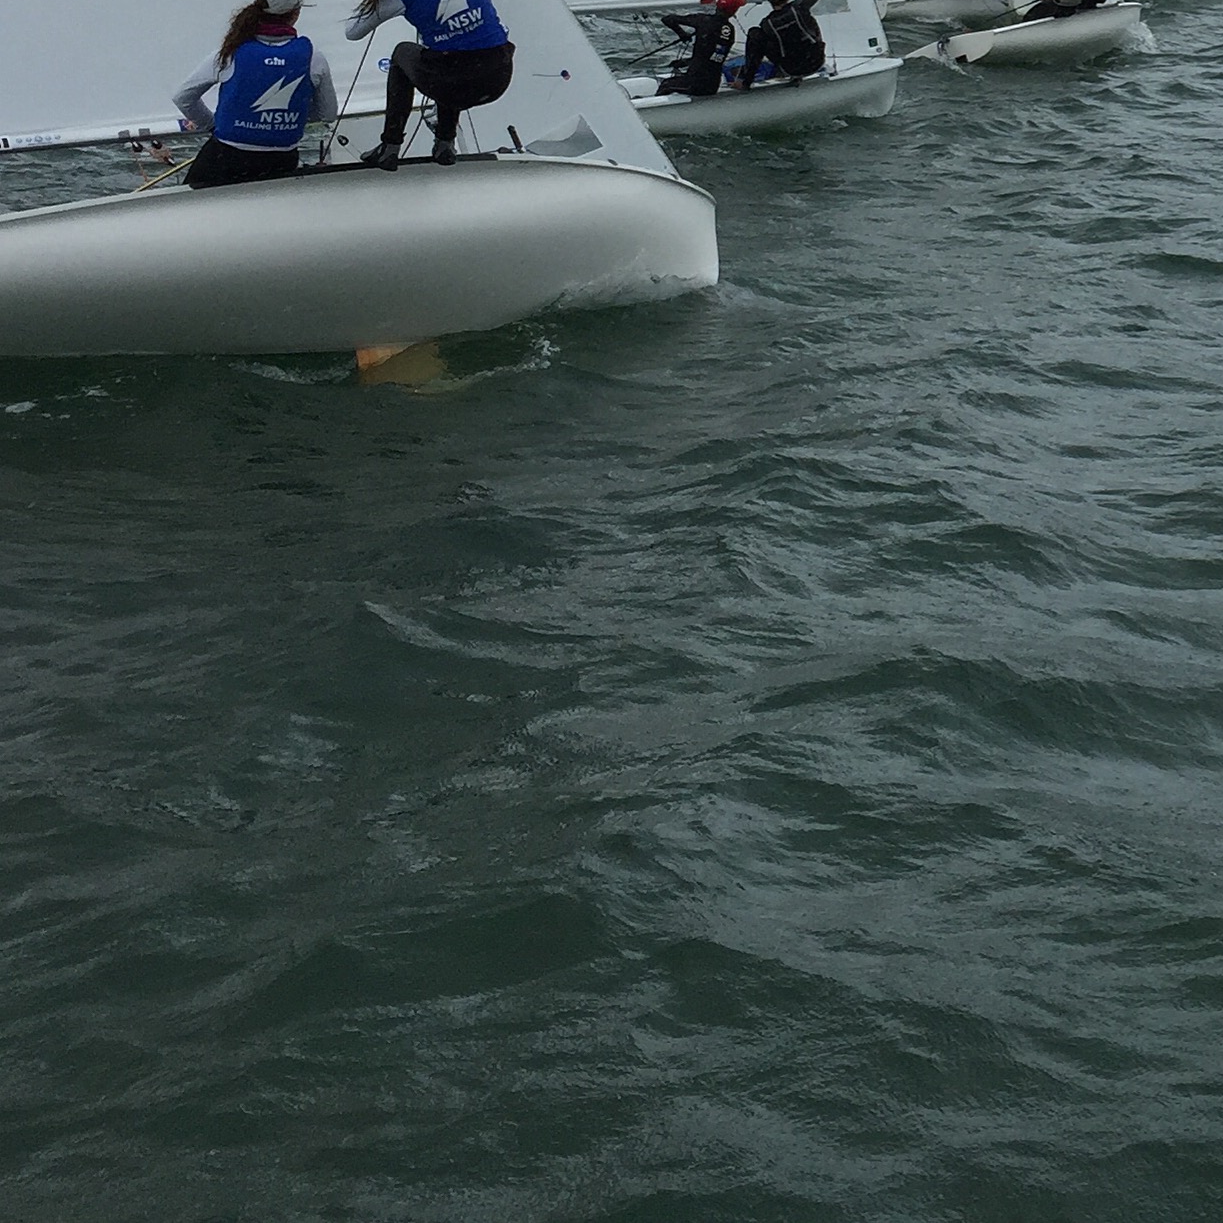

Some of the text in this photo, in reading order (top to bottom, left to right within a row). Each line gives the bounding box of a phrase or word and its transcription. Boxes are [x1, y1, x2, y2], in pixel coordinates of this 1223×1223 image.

[447, 7, 482, 31] NSW
[260, 111, 300, 125] NSW
[234, 120, 272, 131] SAILING
